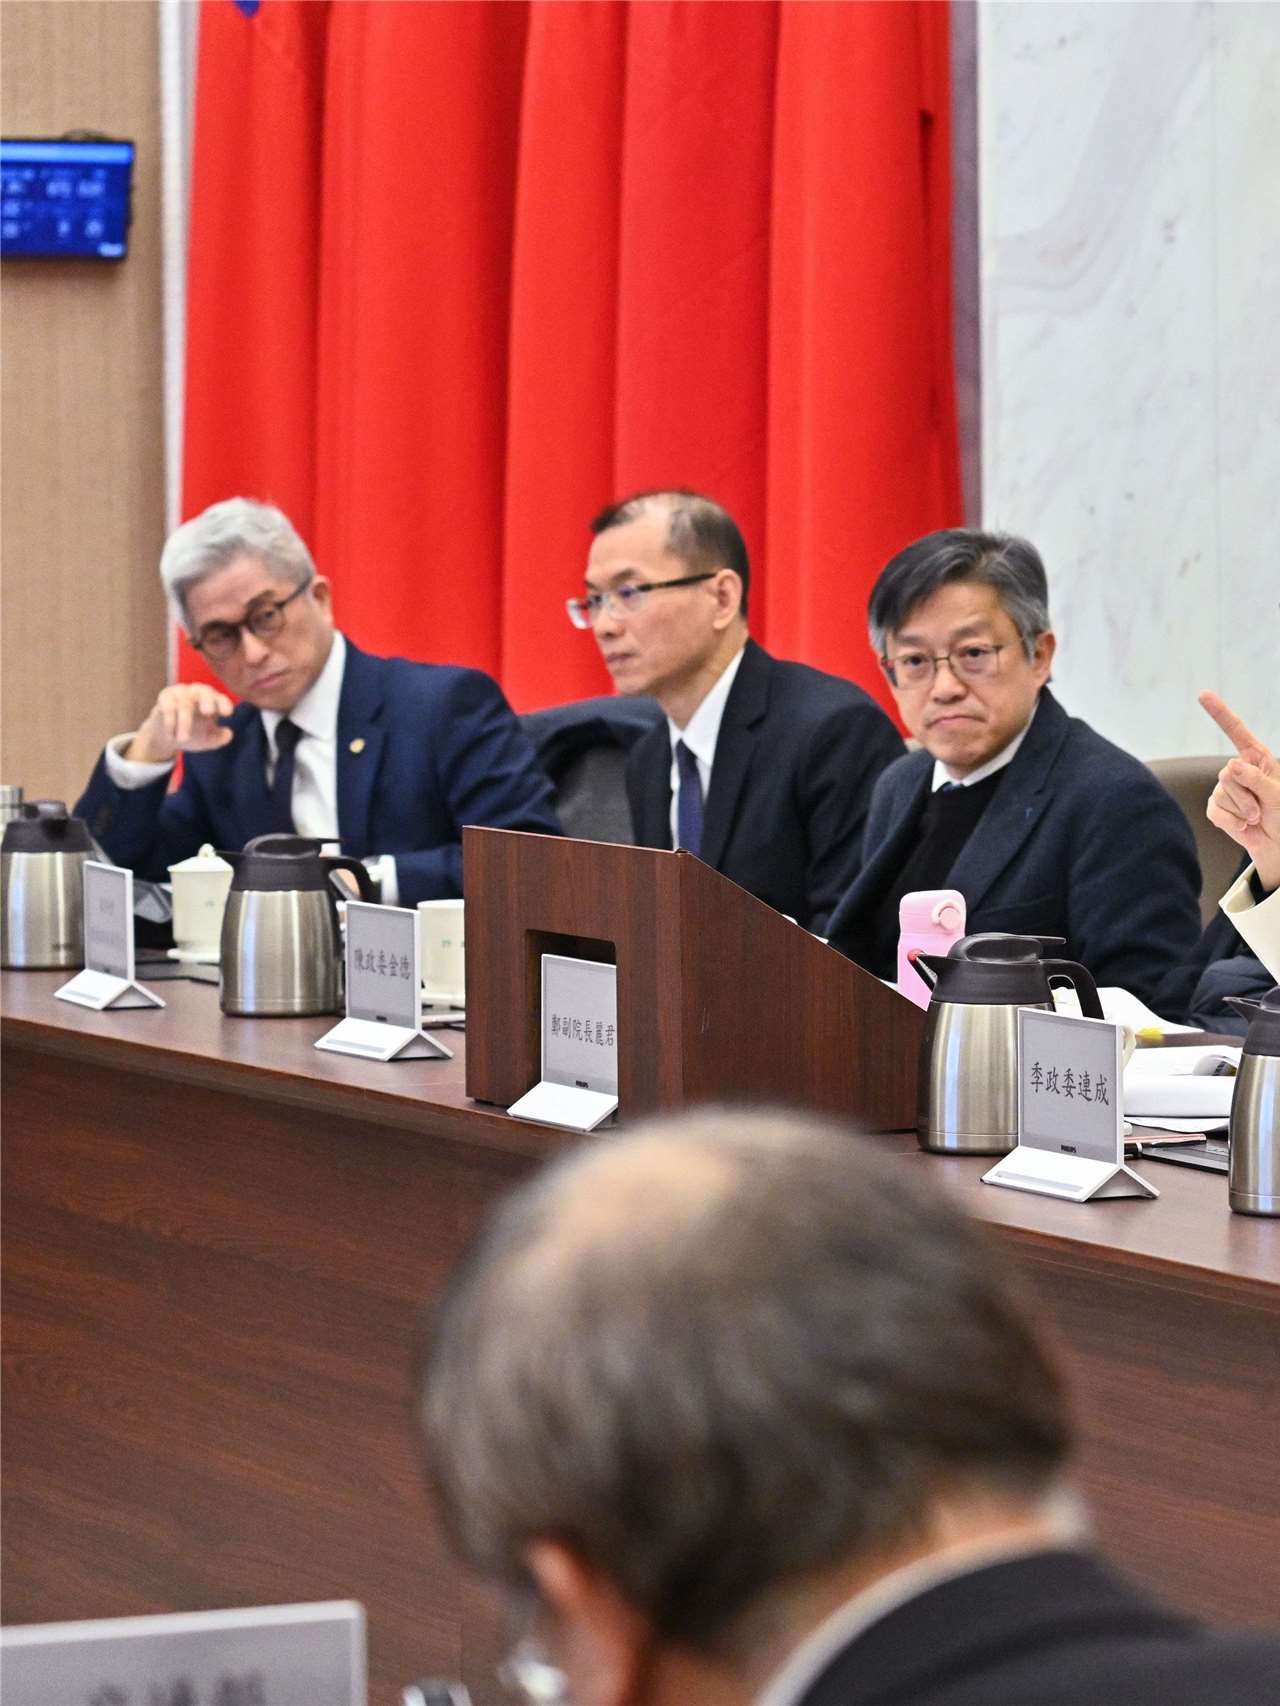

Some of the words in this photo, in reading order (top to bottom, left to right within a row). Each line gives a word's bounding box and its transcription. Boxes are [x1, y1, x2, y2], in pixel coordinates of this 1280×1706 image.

[1029, 1061, 1109, 1106] 季政委連成
